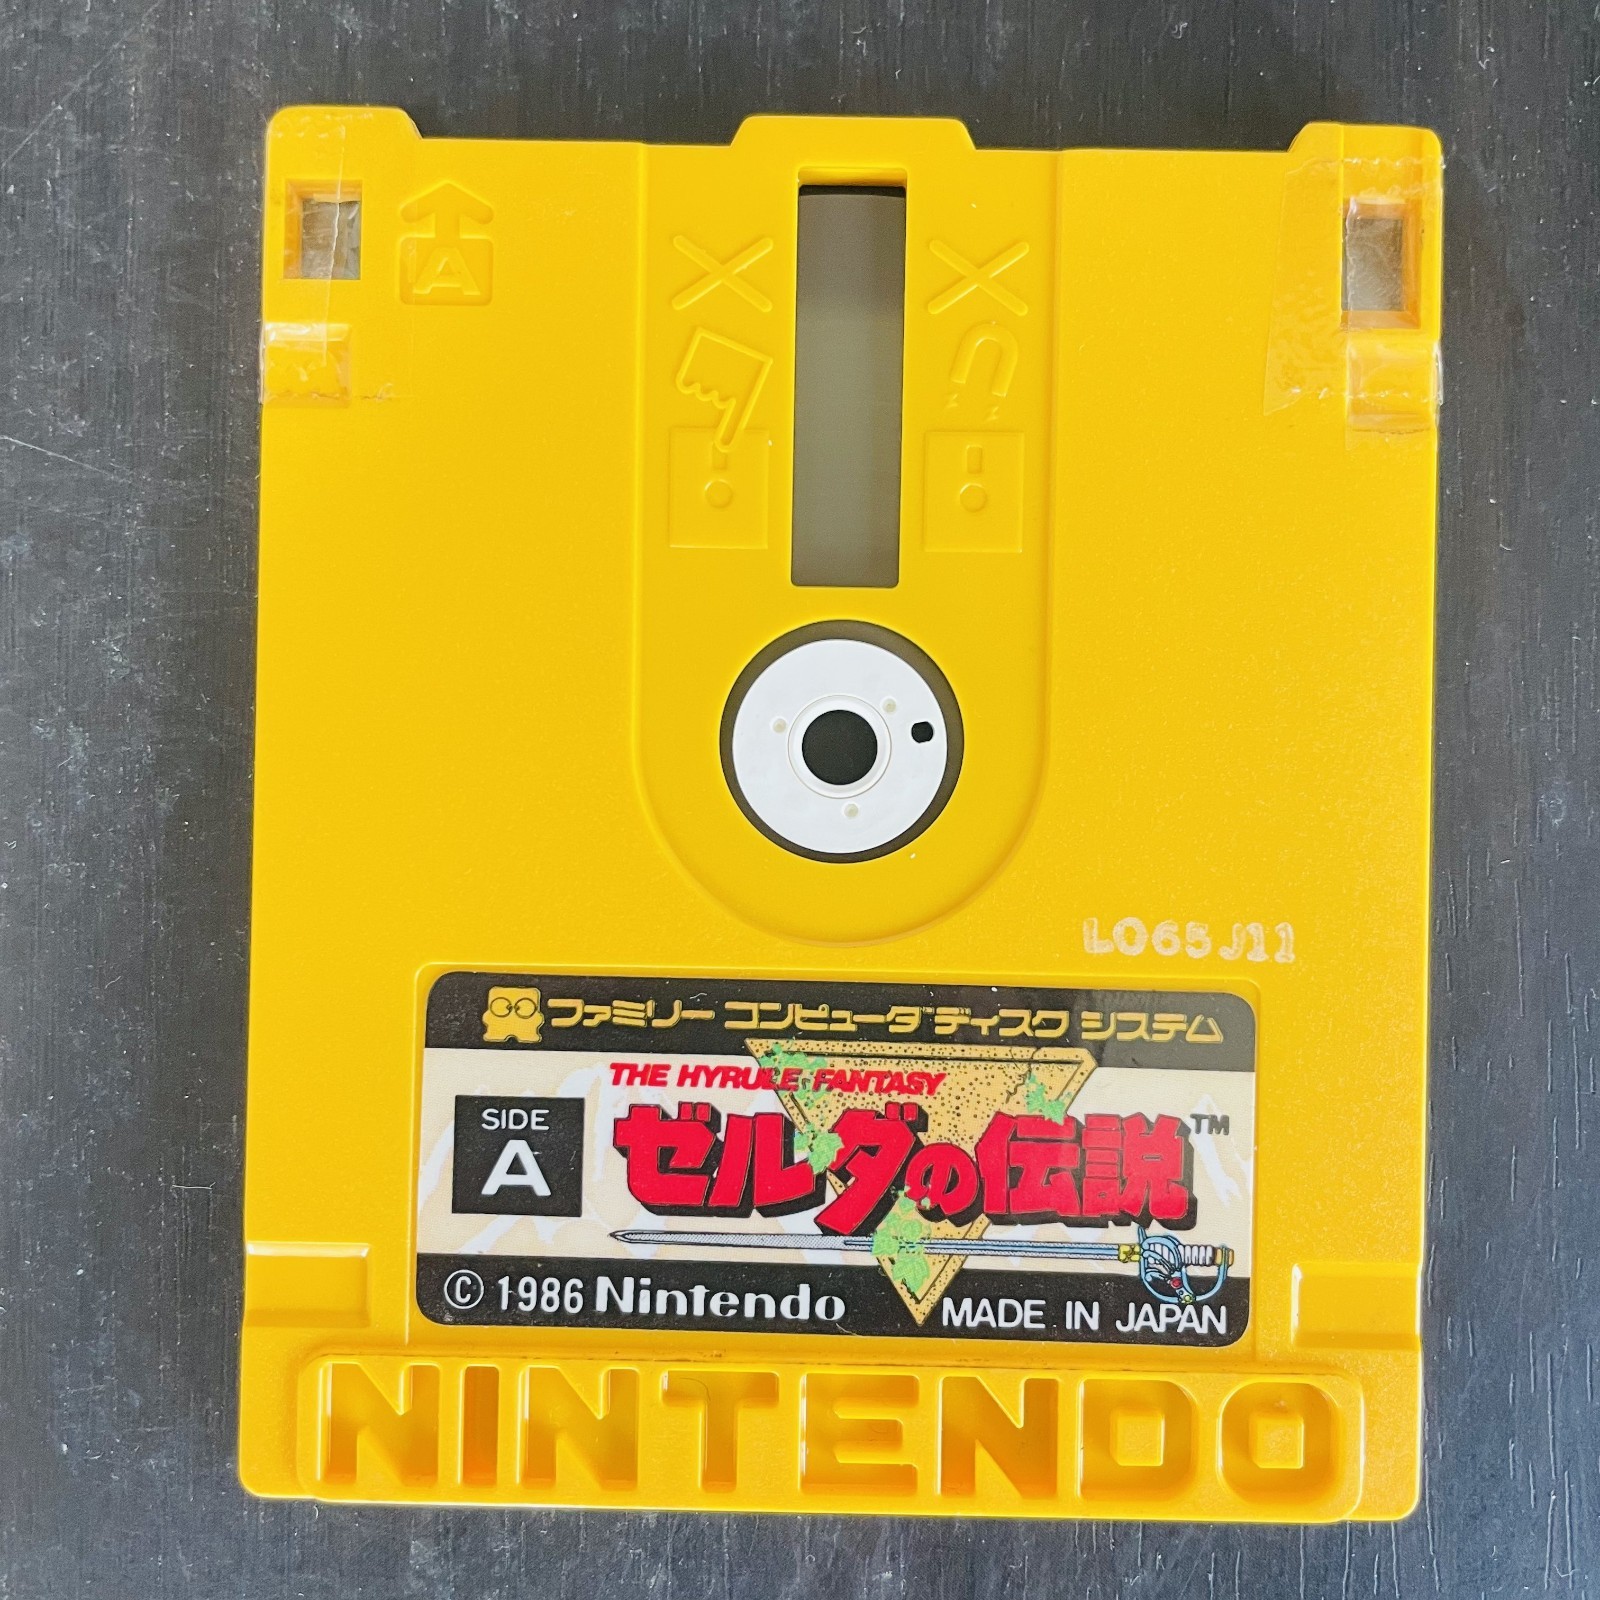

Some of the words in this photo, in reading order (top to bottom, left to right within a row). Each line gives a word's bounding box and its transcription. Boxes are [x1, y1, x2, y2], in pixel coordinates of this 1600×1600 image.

[412, 246, 482, 296] A
[547, 998, 715, 1029] ファミリー
[933, 1006, 1069, 1039] ディスク
[1080, 1011, 1223, 1044] システム
[610, 1062, 671, 1087] THE
[676, 1065, 802, 1092] HYRULE
[812, 1069, 947, 1096] FANTASY
[481, 1108, 550, 1131] SIDE
[480, 1138, 552, 1197] A
[612, 1100, 1199, 1236] ゼルダの伝説
[497, 1275, 584, 1314] 1986
[595, 1275, 846, 1321] Nintendo
[941, 1297, 1047, 1329] MADE
[1065, 1300, 1100, 1331] IN
[1115, 1302, 1228, 1335] JAPAN
[315, 1360, 1345, 1506] NINTENDO
